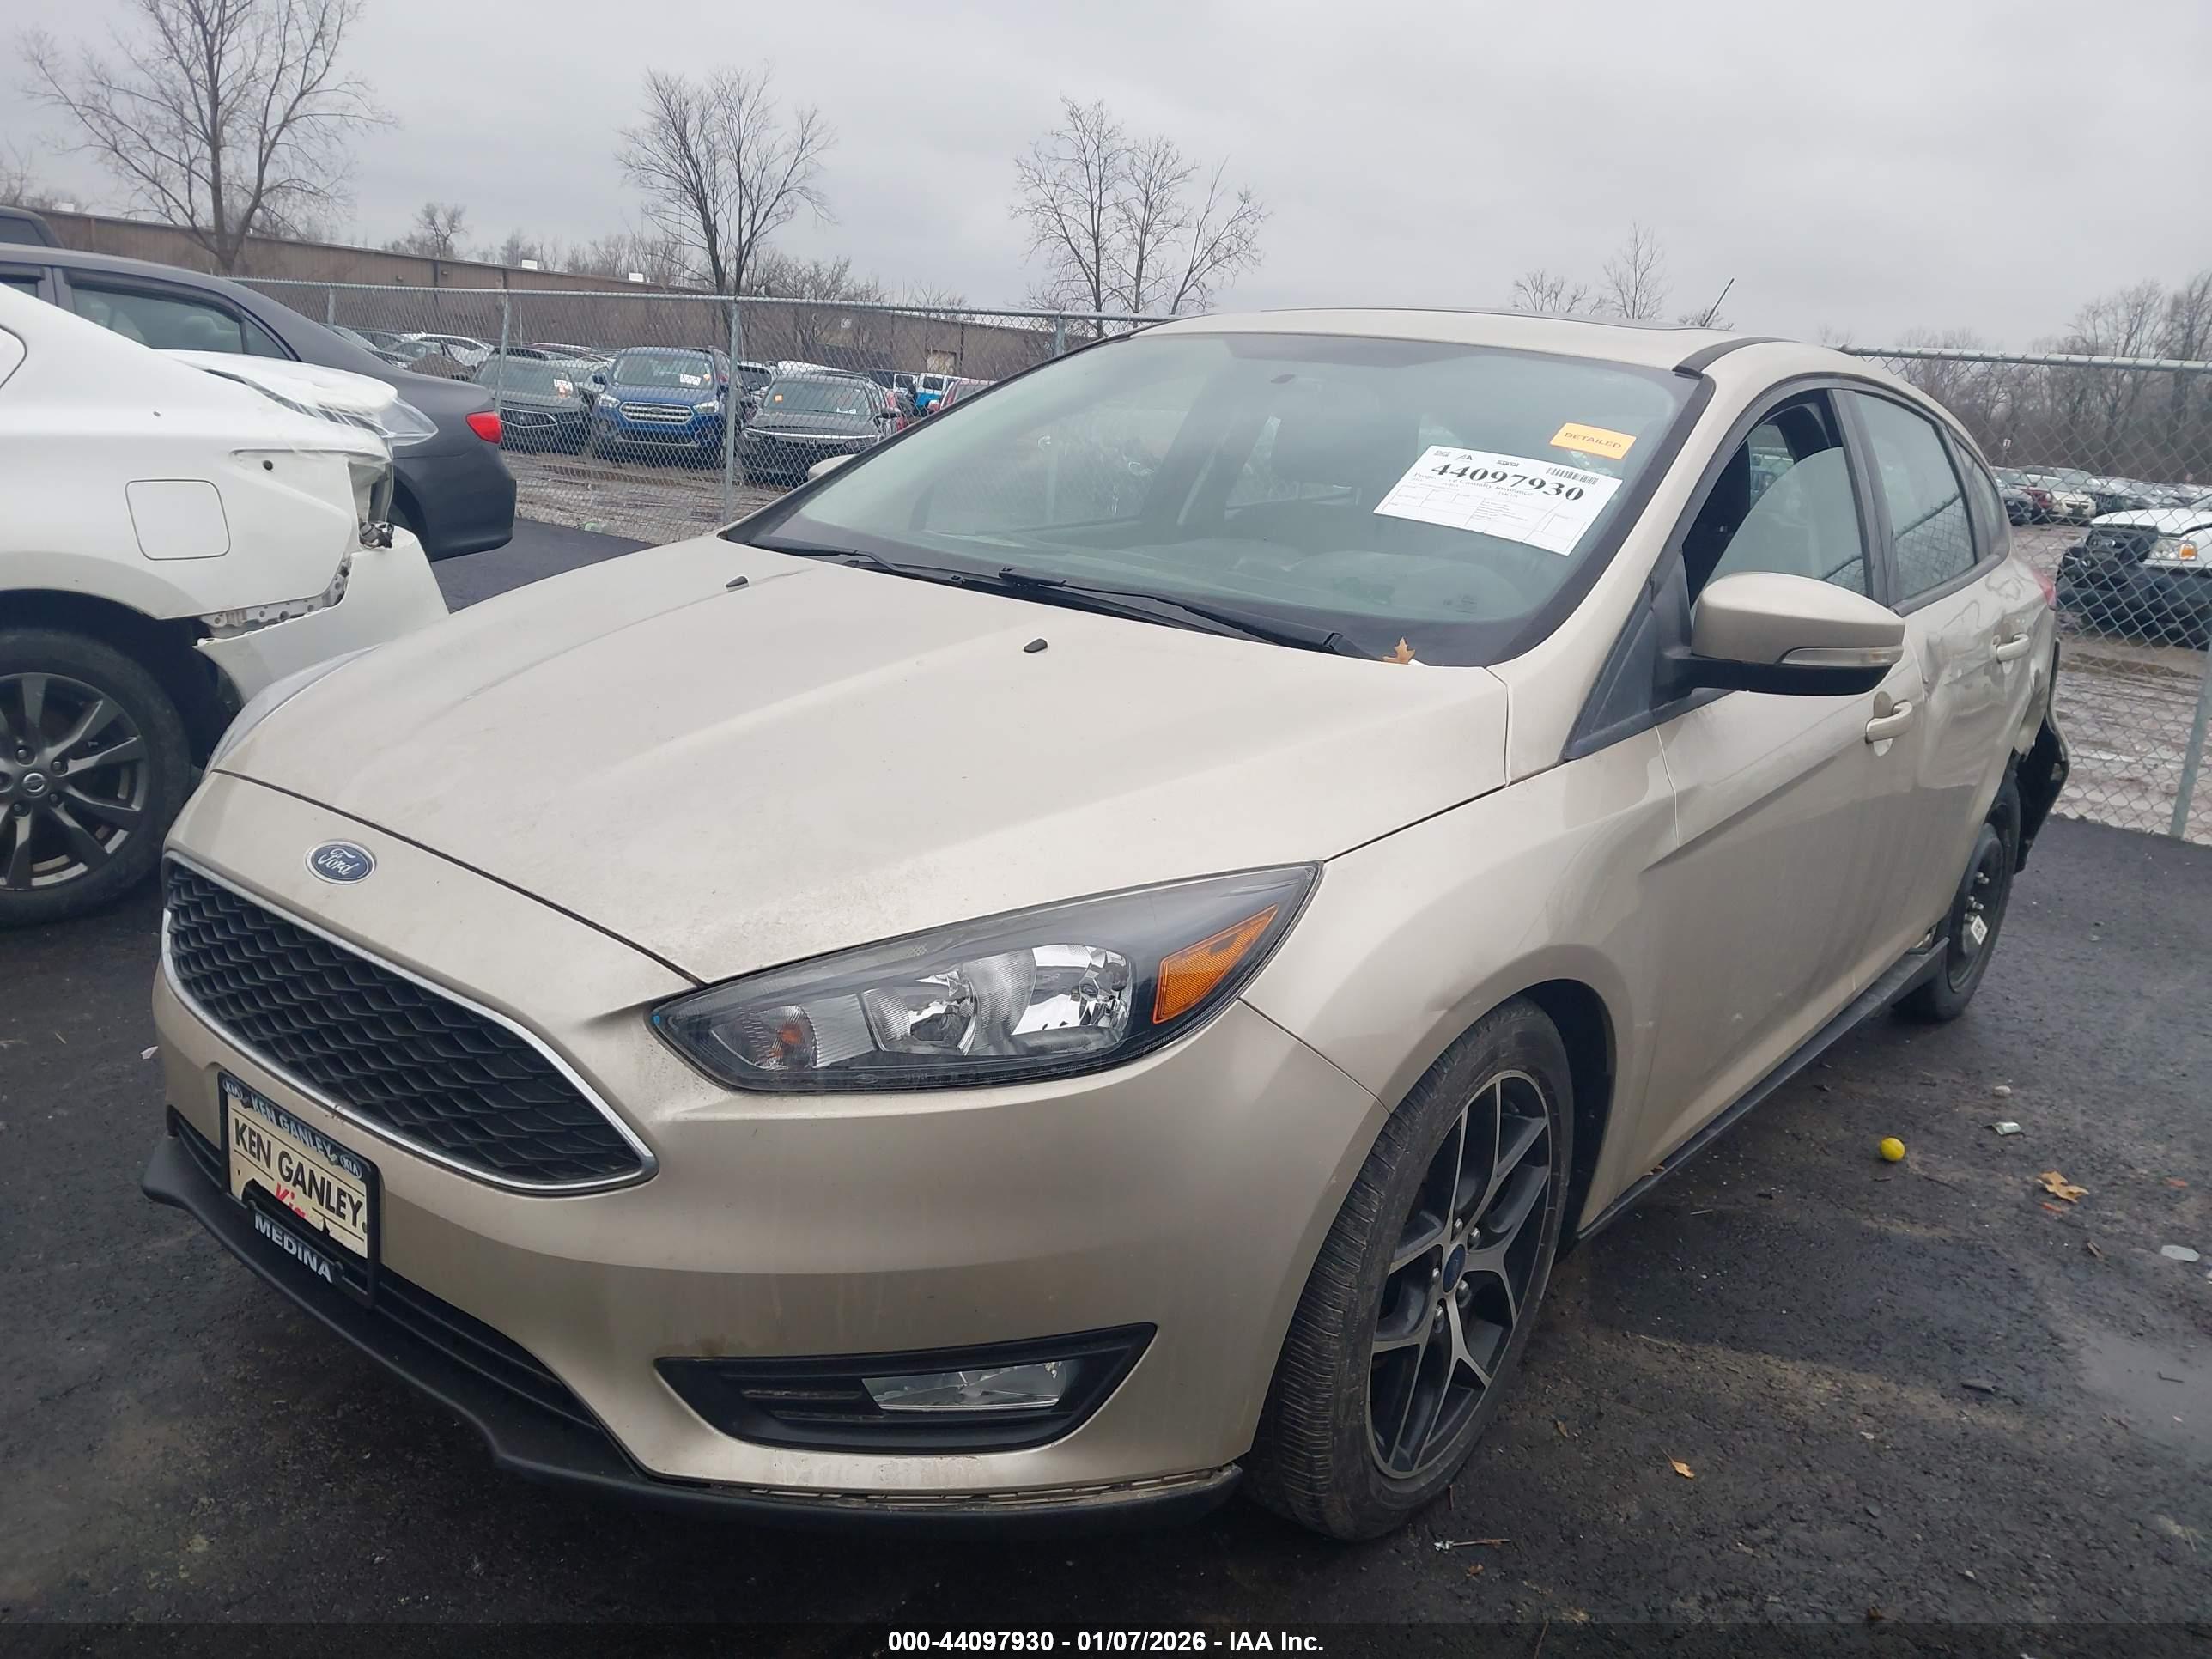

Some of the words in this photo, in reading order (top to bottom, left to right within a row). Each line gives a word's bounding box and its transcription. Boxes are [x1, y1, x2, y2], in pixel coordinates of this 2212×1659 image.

[1563, 431, 1622, 449] DETAILED
[1431, 463, 1585, 501] 44097930
[317, 848, 360, 876] Ford
[223, 1079, 241, 1098] KIA
[251, 1094, 278, 1127] KEN
[278, 1114, 333, 1158] GANLEY
[341, 1156, 360, 1176] KIA
[234, 1118, 272, 1170] KEN
[277, 1150, 363, 1228] GANLEY
[254, 1213, 334, 1284] MEDINA
